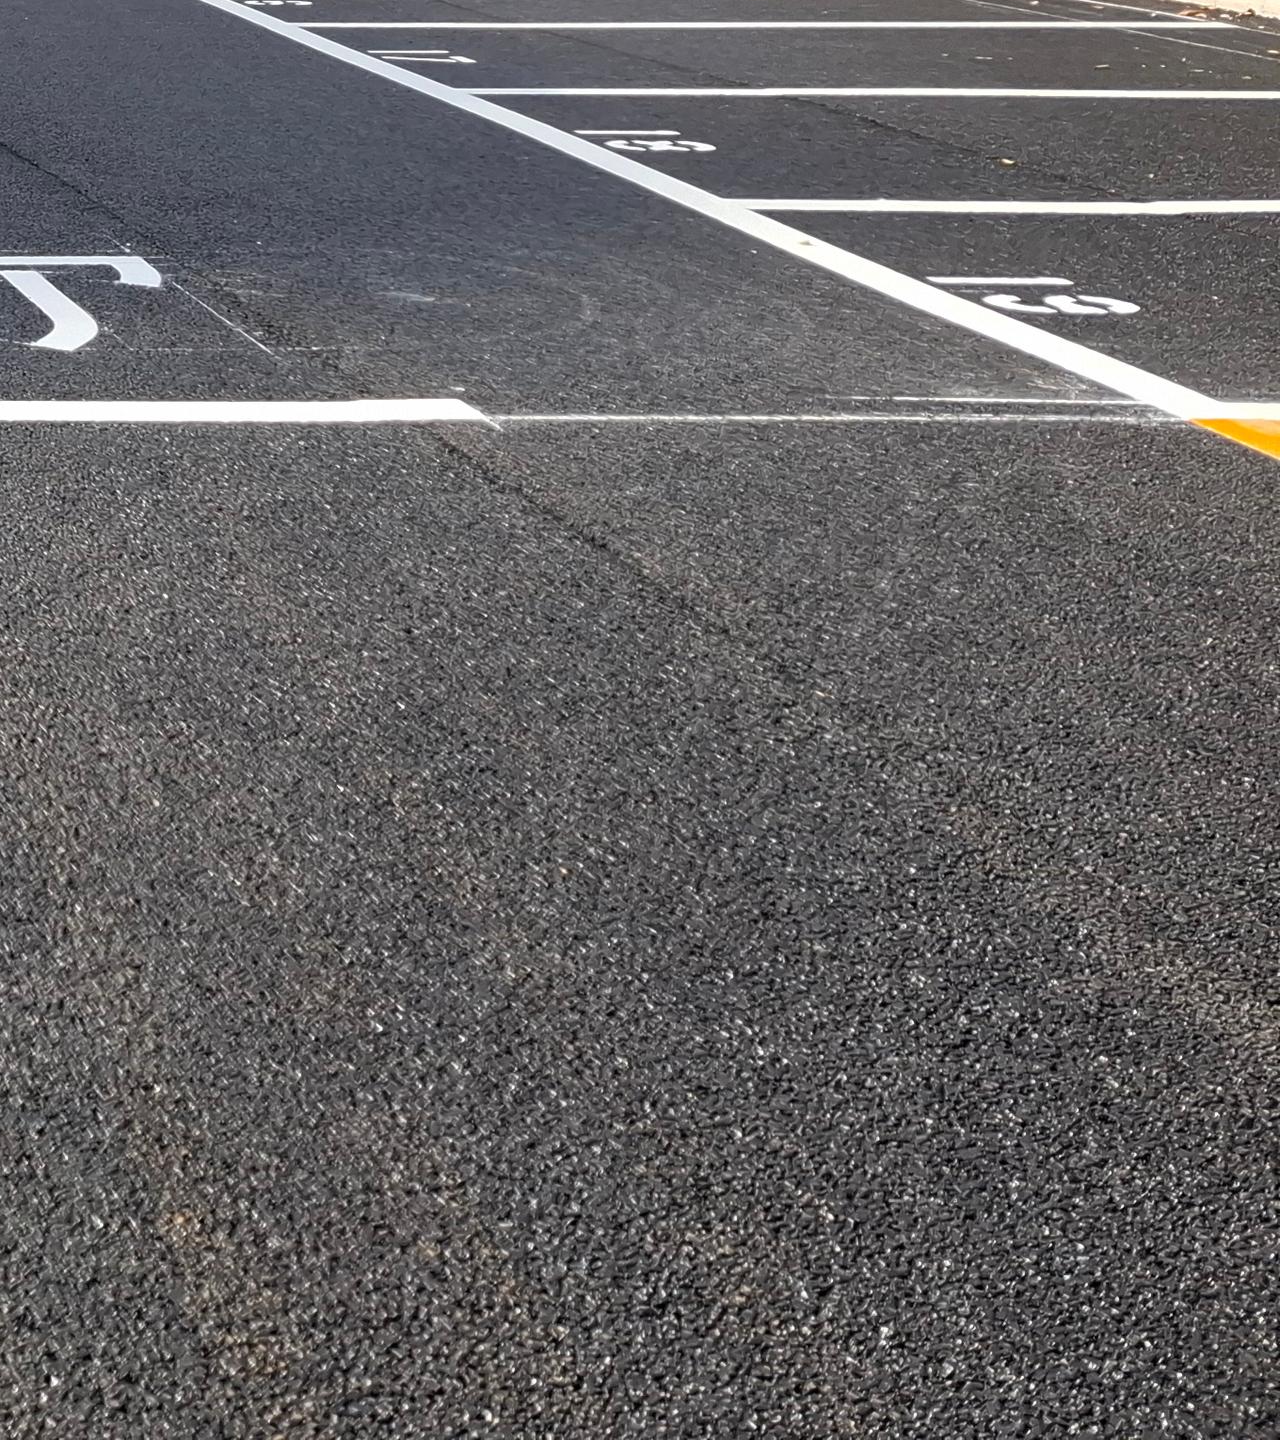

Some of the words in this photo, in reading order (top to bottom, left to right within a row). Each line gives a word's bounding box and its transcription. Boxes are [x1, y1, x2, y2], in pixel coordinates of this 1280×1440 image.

[366, 50, 478, 63] 17
[574, 128, 718, 152] 18
[924, 275, 1142, 315] 19
